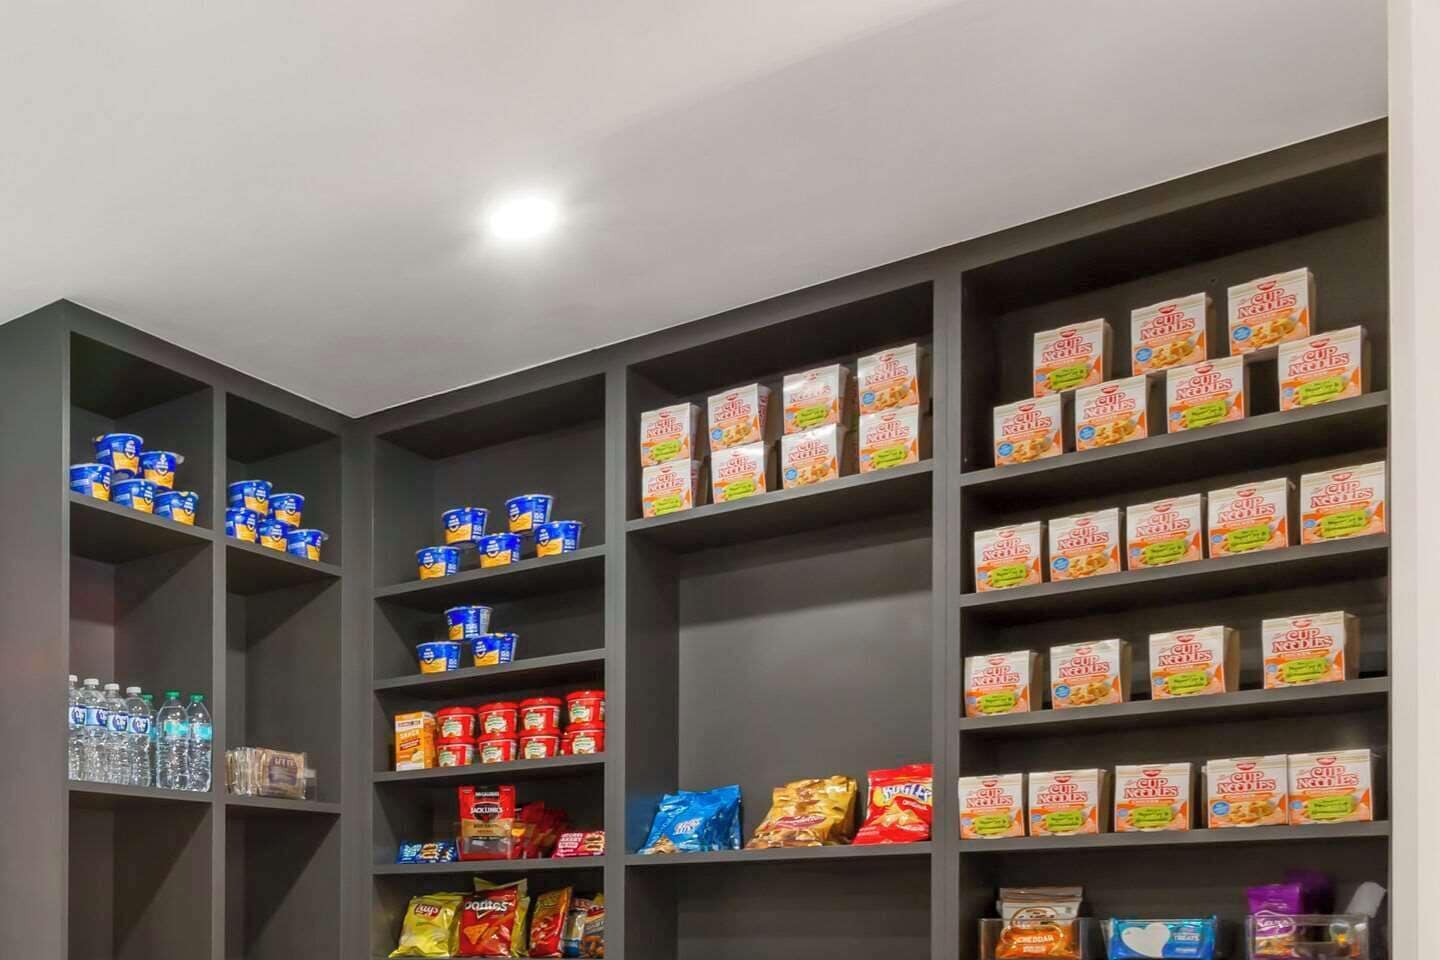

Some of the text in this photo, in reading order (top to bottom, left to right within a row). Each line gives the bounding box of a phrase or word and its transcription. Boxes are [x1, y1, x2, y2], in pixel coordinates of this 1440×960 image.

[1251, 288, 1284, 305] CUP
[1238, 294, 1296, 318] NOODLES
[1152, 313, 1183, 329] CUP
[1141, 320, 1195, 340] NOODLES
[1054, 336, 1083, 352] CUP
[1041, 344, 1093, 363] NOODLES
[1302, 347, 1337, 365] CUP
[1289, 353, 1349, 375] NOODLES
[1189, 372, 1220, 387] CUP
[1176, 378, 1232, 399] NOODLES
[1096, 392, 1125, 407] CUP
[1083, 399, 1135, 419] NOODLES
[1013, 410, 1041, 426] CUP
[1002, 417, 1051, 436] NOODLES
[1326, 481, 1360, 495] CUP
[1232, 496, 1264, 510] CUP
[1311, 488, 1373, 508] NOODLES
[1152, 512, 1178, 527] CUP
[1218, 504, 1275, 523] NOODLES
[1071, 526, 1097, 538] CUP
[1136, 518, 1190, 537] NOODLES
[1058, 532, 1108, 550] NOODLES
[983, 545, 1031, 561] NOODLES
[1287, 628, 1319, 641] CUP
[1172, 643, 1202, 655] CUP
[1272, 636, 1333, 653] NOODLES
[1072, 655, 1099, 667] CUP
[1158, 651, 1212, 666] NOODLES
[1059, 662, 1110, 677] NOODLES
[1232, 771, 1264, 783] CUP
[1312, 766, 1345, 777] CUP
[1049, 784, 1077, 794] CUP
[1137, 778, 1168, 788] CUP
[1217, 779, 1276, 793] NOODLES
[1297, 774, 1358, 789] NOODLES
[977, 788, 1003, 799] CUP
[1037, 791, 1088, 804] NOODLES
[1124, 786, 1178, 799] NOODLES
[967, 796, 1013, 808] NOODLES
